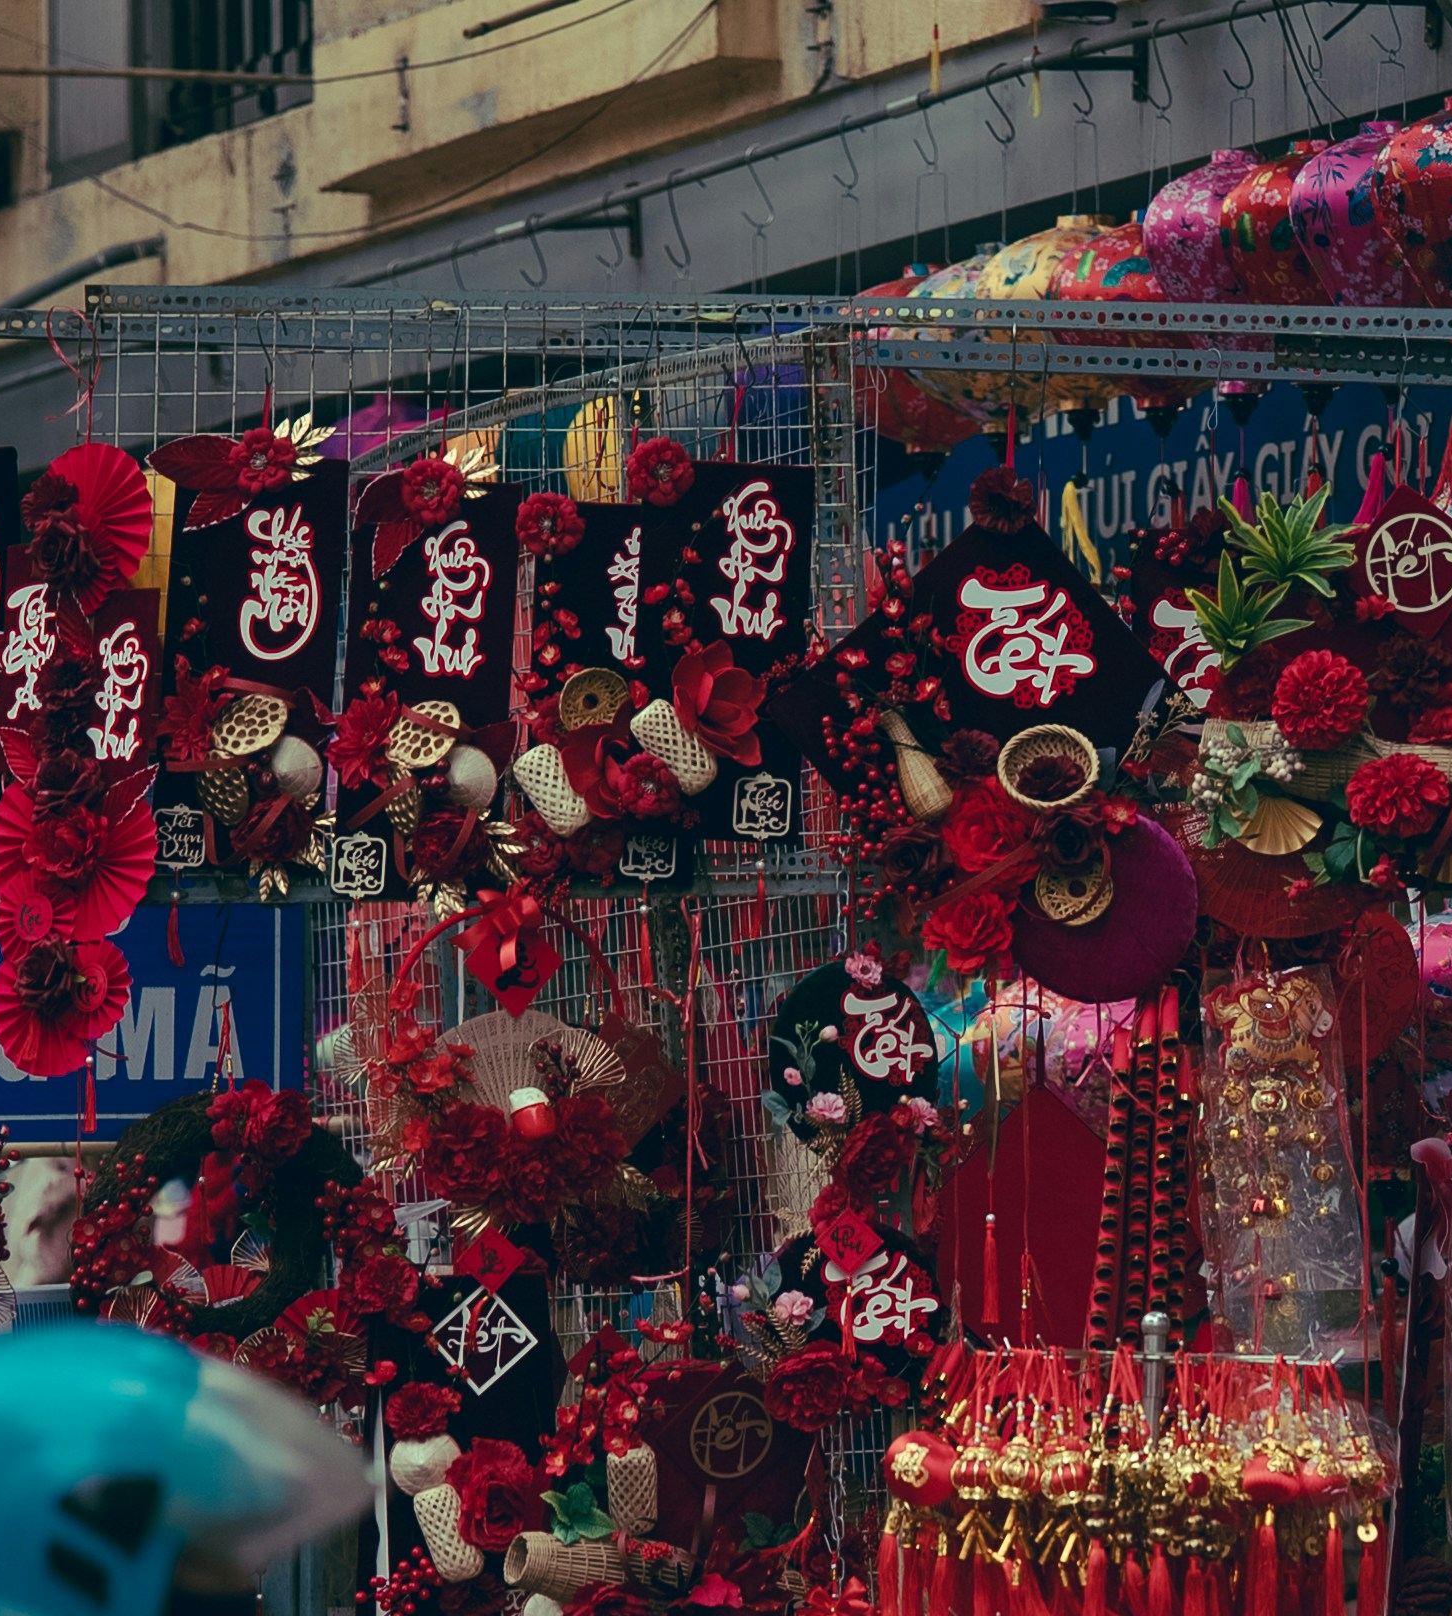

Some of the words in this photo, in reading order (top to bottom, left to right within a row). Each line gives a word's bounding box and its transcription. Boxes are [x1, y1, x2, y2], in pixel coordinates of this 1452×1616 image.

[1254, 412, 1344, 505] GIẤY
[960, 578, 1095, 705] Tết
[97, 964, 245, 1082] MÃ
[844, 992, 933, 1082] Tết
[824, 1252, 939, 1340] Tết
